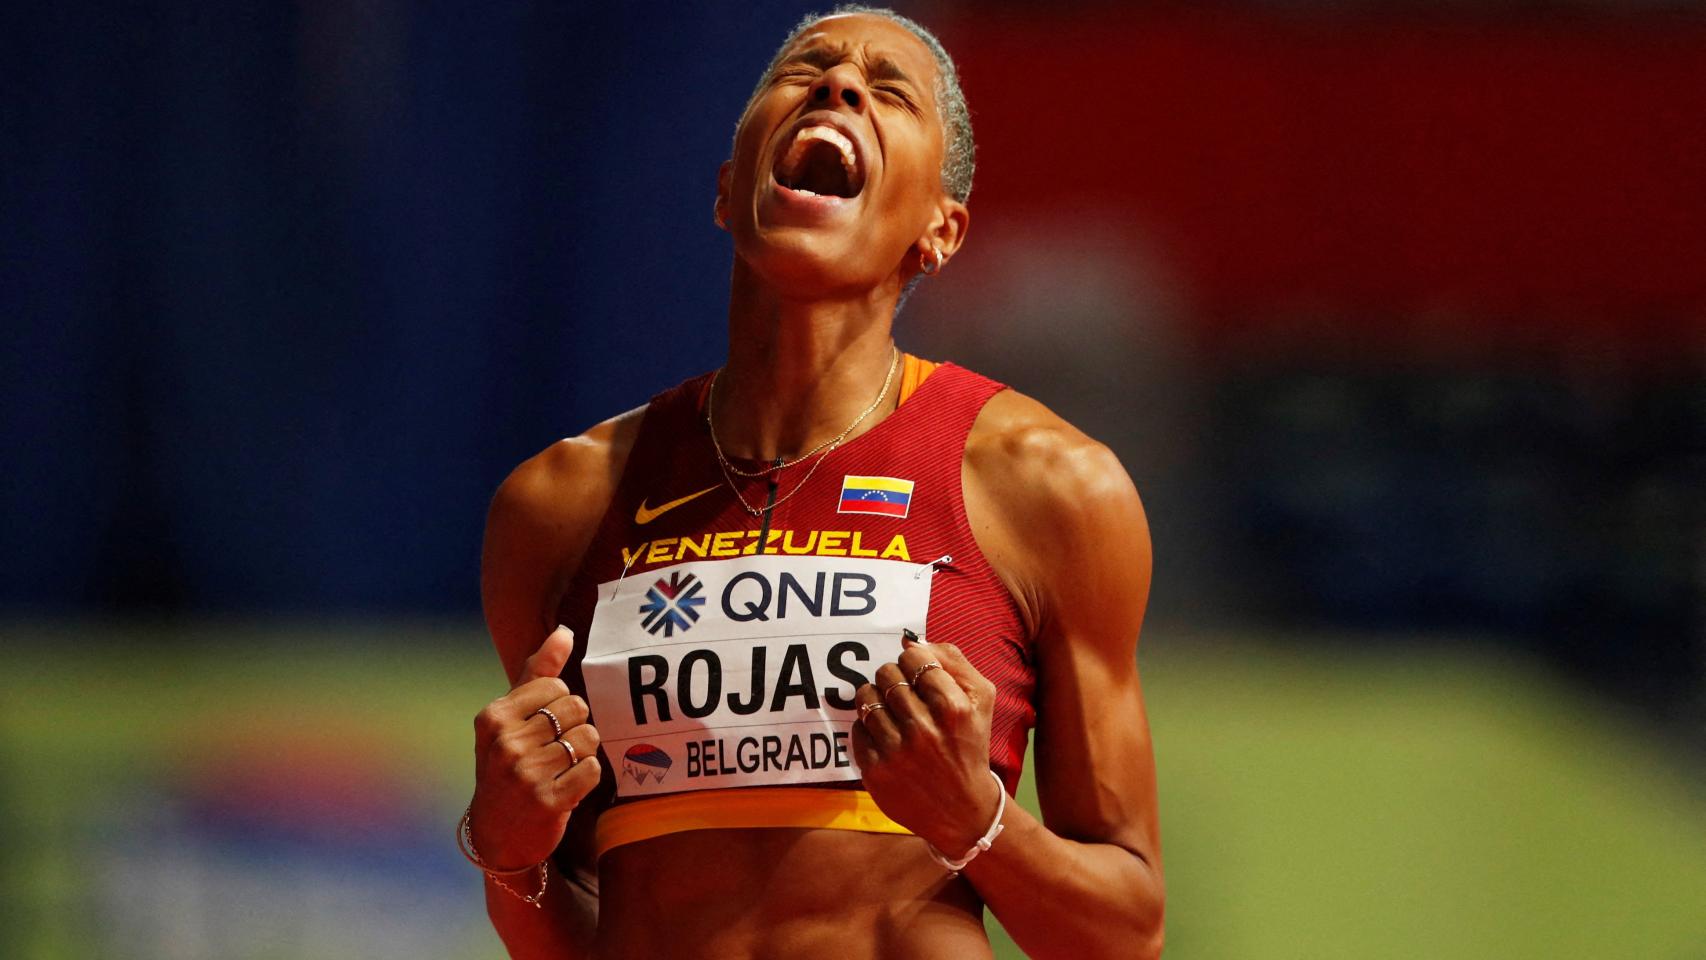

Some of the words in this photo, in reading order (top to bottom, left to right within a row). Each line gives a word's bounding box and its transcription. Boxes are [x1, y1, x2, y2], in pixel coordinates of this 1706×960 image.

[621, 529, 911, 568] VENEZUELA
[721, 571, 877, 622] QNB
[628, 641, 870, 725] ROJAS
[686, 731, 850, 778] BELGRADE
